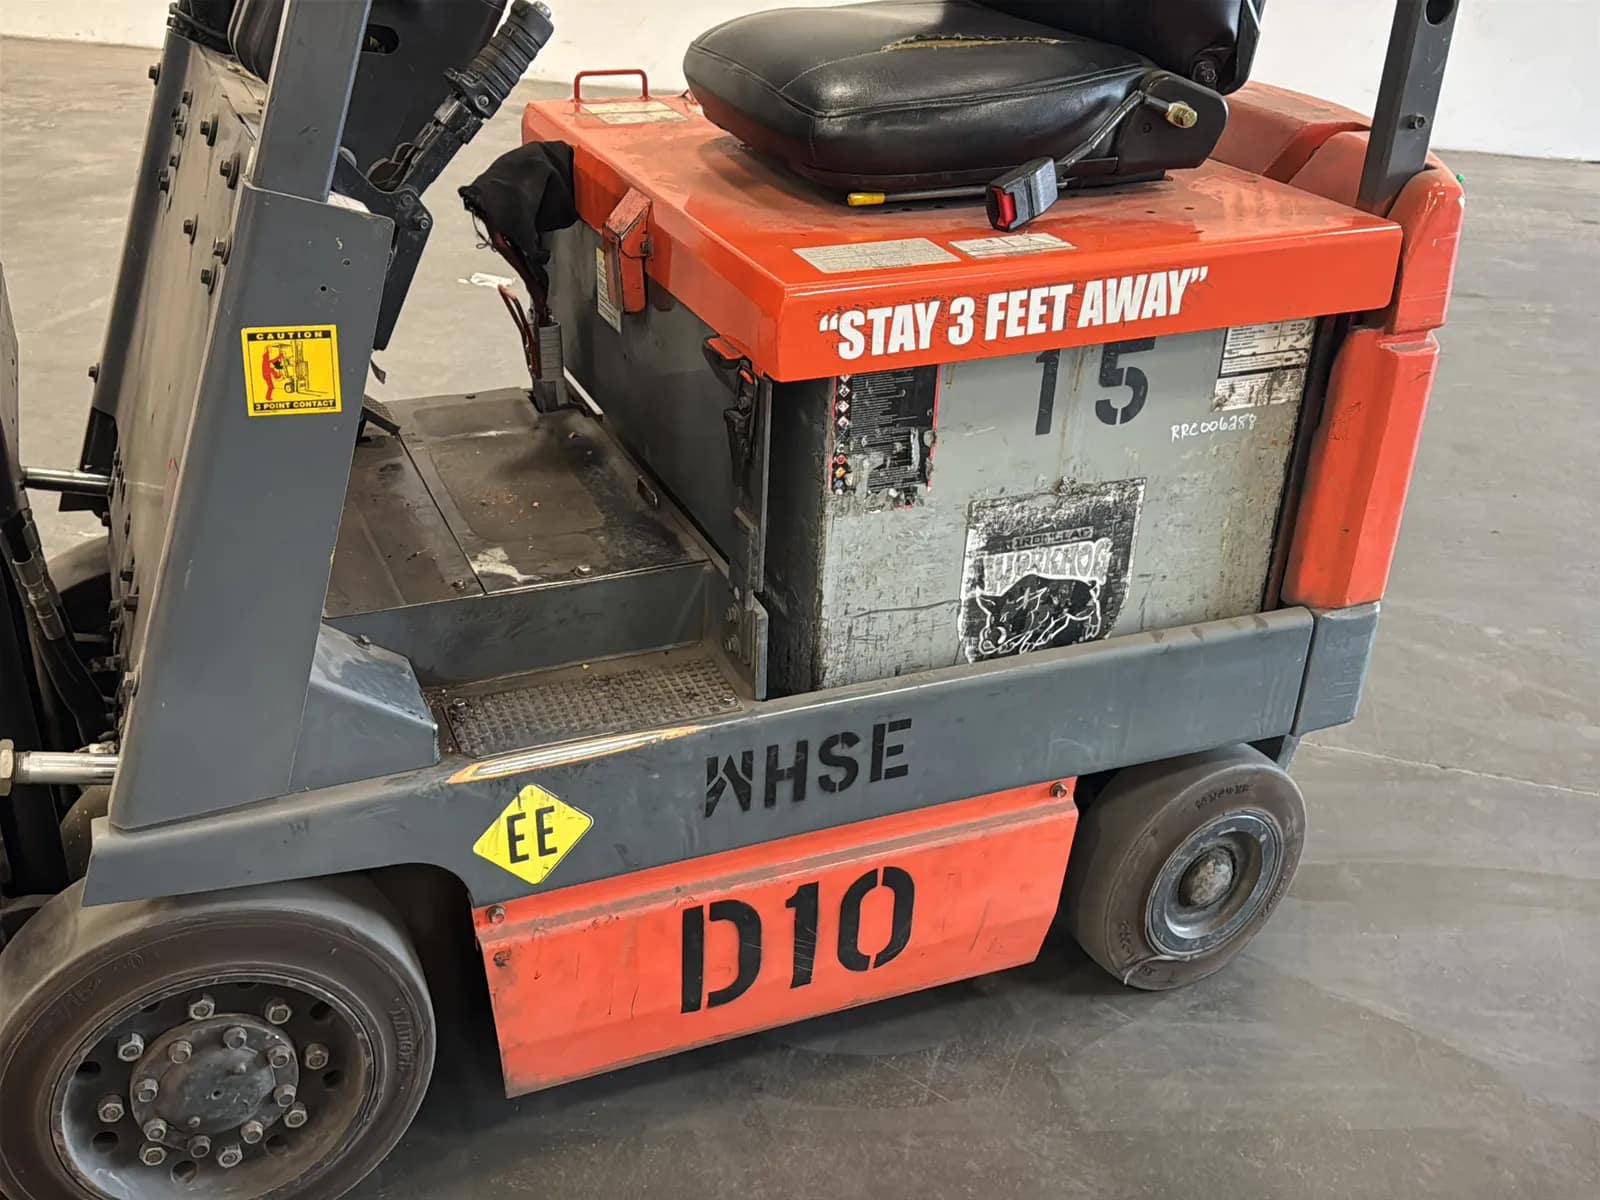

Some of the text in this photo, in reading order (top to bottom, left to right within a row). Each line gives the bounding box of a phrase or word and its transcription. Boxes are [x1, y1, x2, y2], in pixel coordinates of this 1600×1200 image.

[256, 331, 322, 340] CAUTION
[948, 297, 975, 346] 3
[985, 284, 1074, 342] FEET
[293, 399, 334, 408] CONTACT
[704, 717, 912, 818] WHSE
[506, 805, 558, 864] EE
[681, 866, 916, 1014] D10
